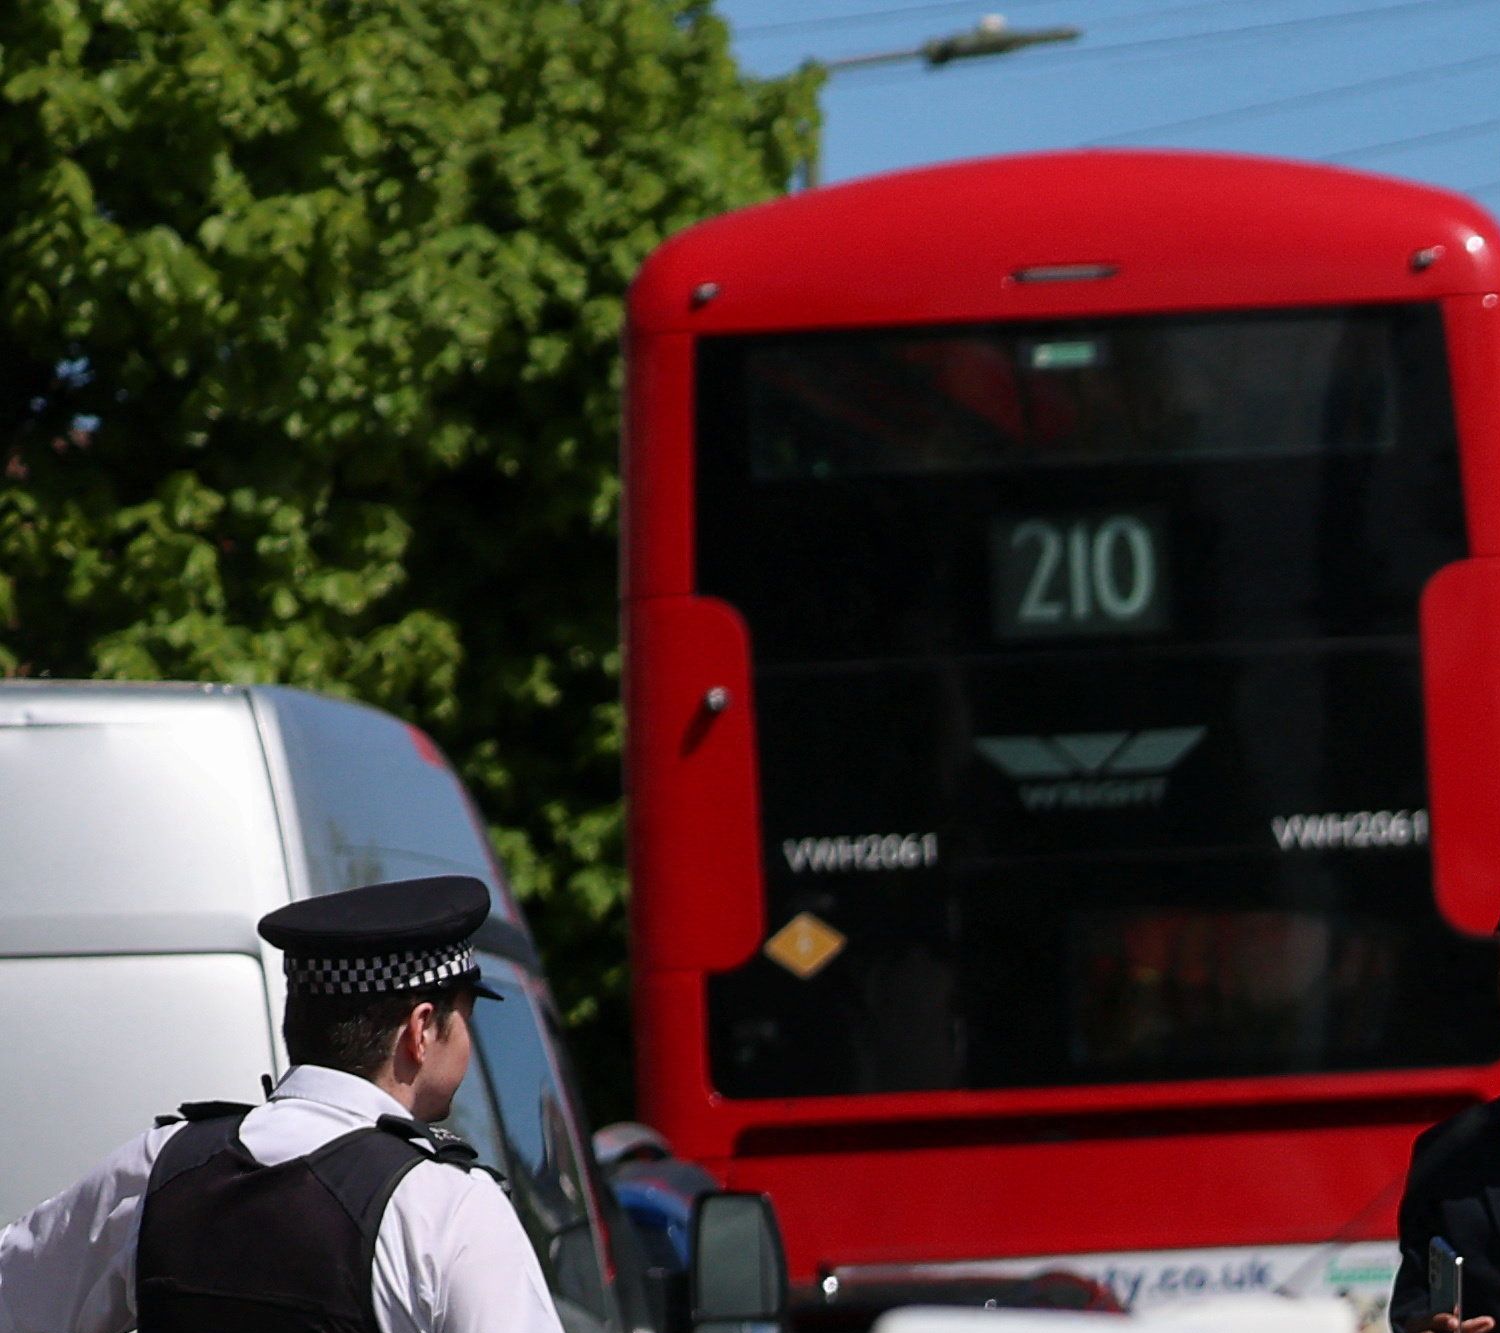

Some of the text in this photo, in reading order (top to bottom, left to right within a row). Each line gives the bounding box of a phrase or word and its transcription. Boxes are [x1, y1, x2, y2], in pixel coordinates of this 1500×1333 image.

[1010, 513, 1156, 623] 210
[1270, 807, 1429, 852] VWH2061
[782, 832, 938, 874] VWH2061
